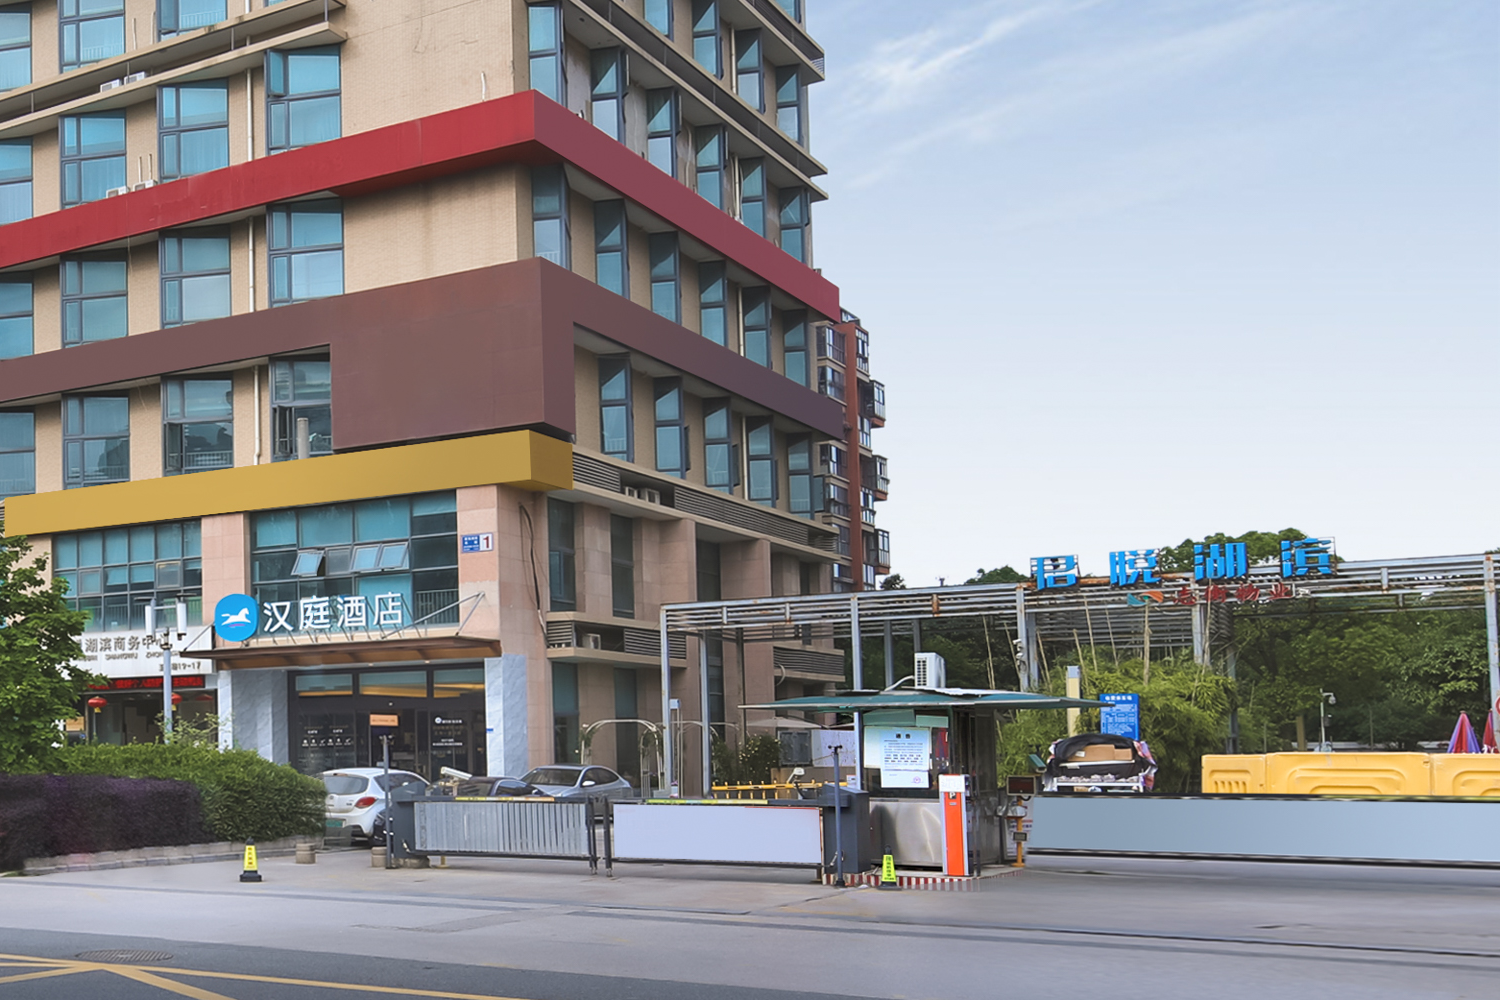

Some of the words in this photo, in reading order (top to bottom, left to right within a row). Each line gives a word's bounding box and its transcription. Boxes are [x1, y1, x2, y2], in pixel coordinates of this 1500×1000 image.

[483, 535, 490, 548] 1
[263, 591, 403, 633] 汉庭酒店
